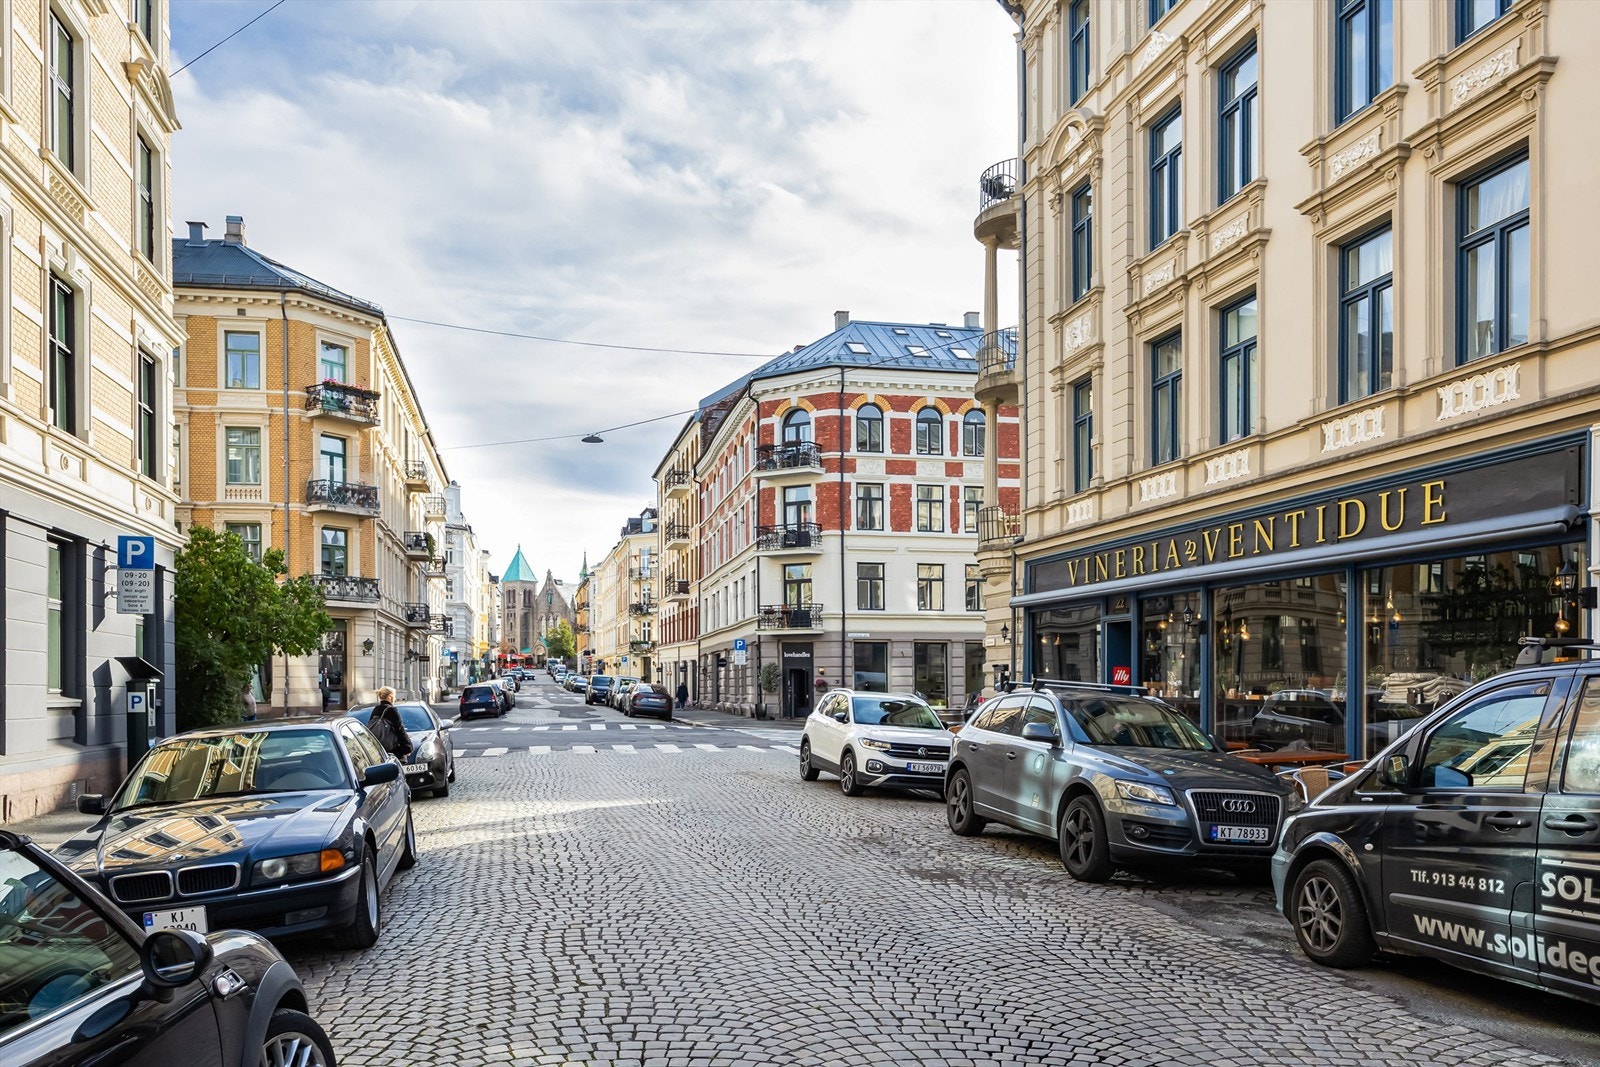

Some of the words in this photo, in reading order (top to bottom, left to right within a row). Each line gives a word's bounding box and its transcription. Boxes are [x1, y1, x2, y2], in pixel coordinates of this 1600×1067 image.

[1067, 538, 1182, 585] VINERIA
[1202, 480, 1447, 562] VENTIDUE
[126, 540, 146, 565] P
[736, 640, 744, 649] P
[1114, 669, 1130, 684] illy
[131, 695, 143, 709] P
[1220, 827, 1233, 838] KT
[1237, 828, 1267, 840] 78933
[1410, 869, 1430, 883] Tlf.
[1431, 872, 1456, 887] 913
[1460, 876, 1476, 888] 44
[1478, 878, 1505, 894] 812
[170, 911, 184, 923] KJ
